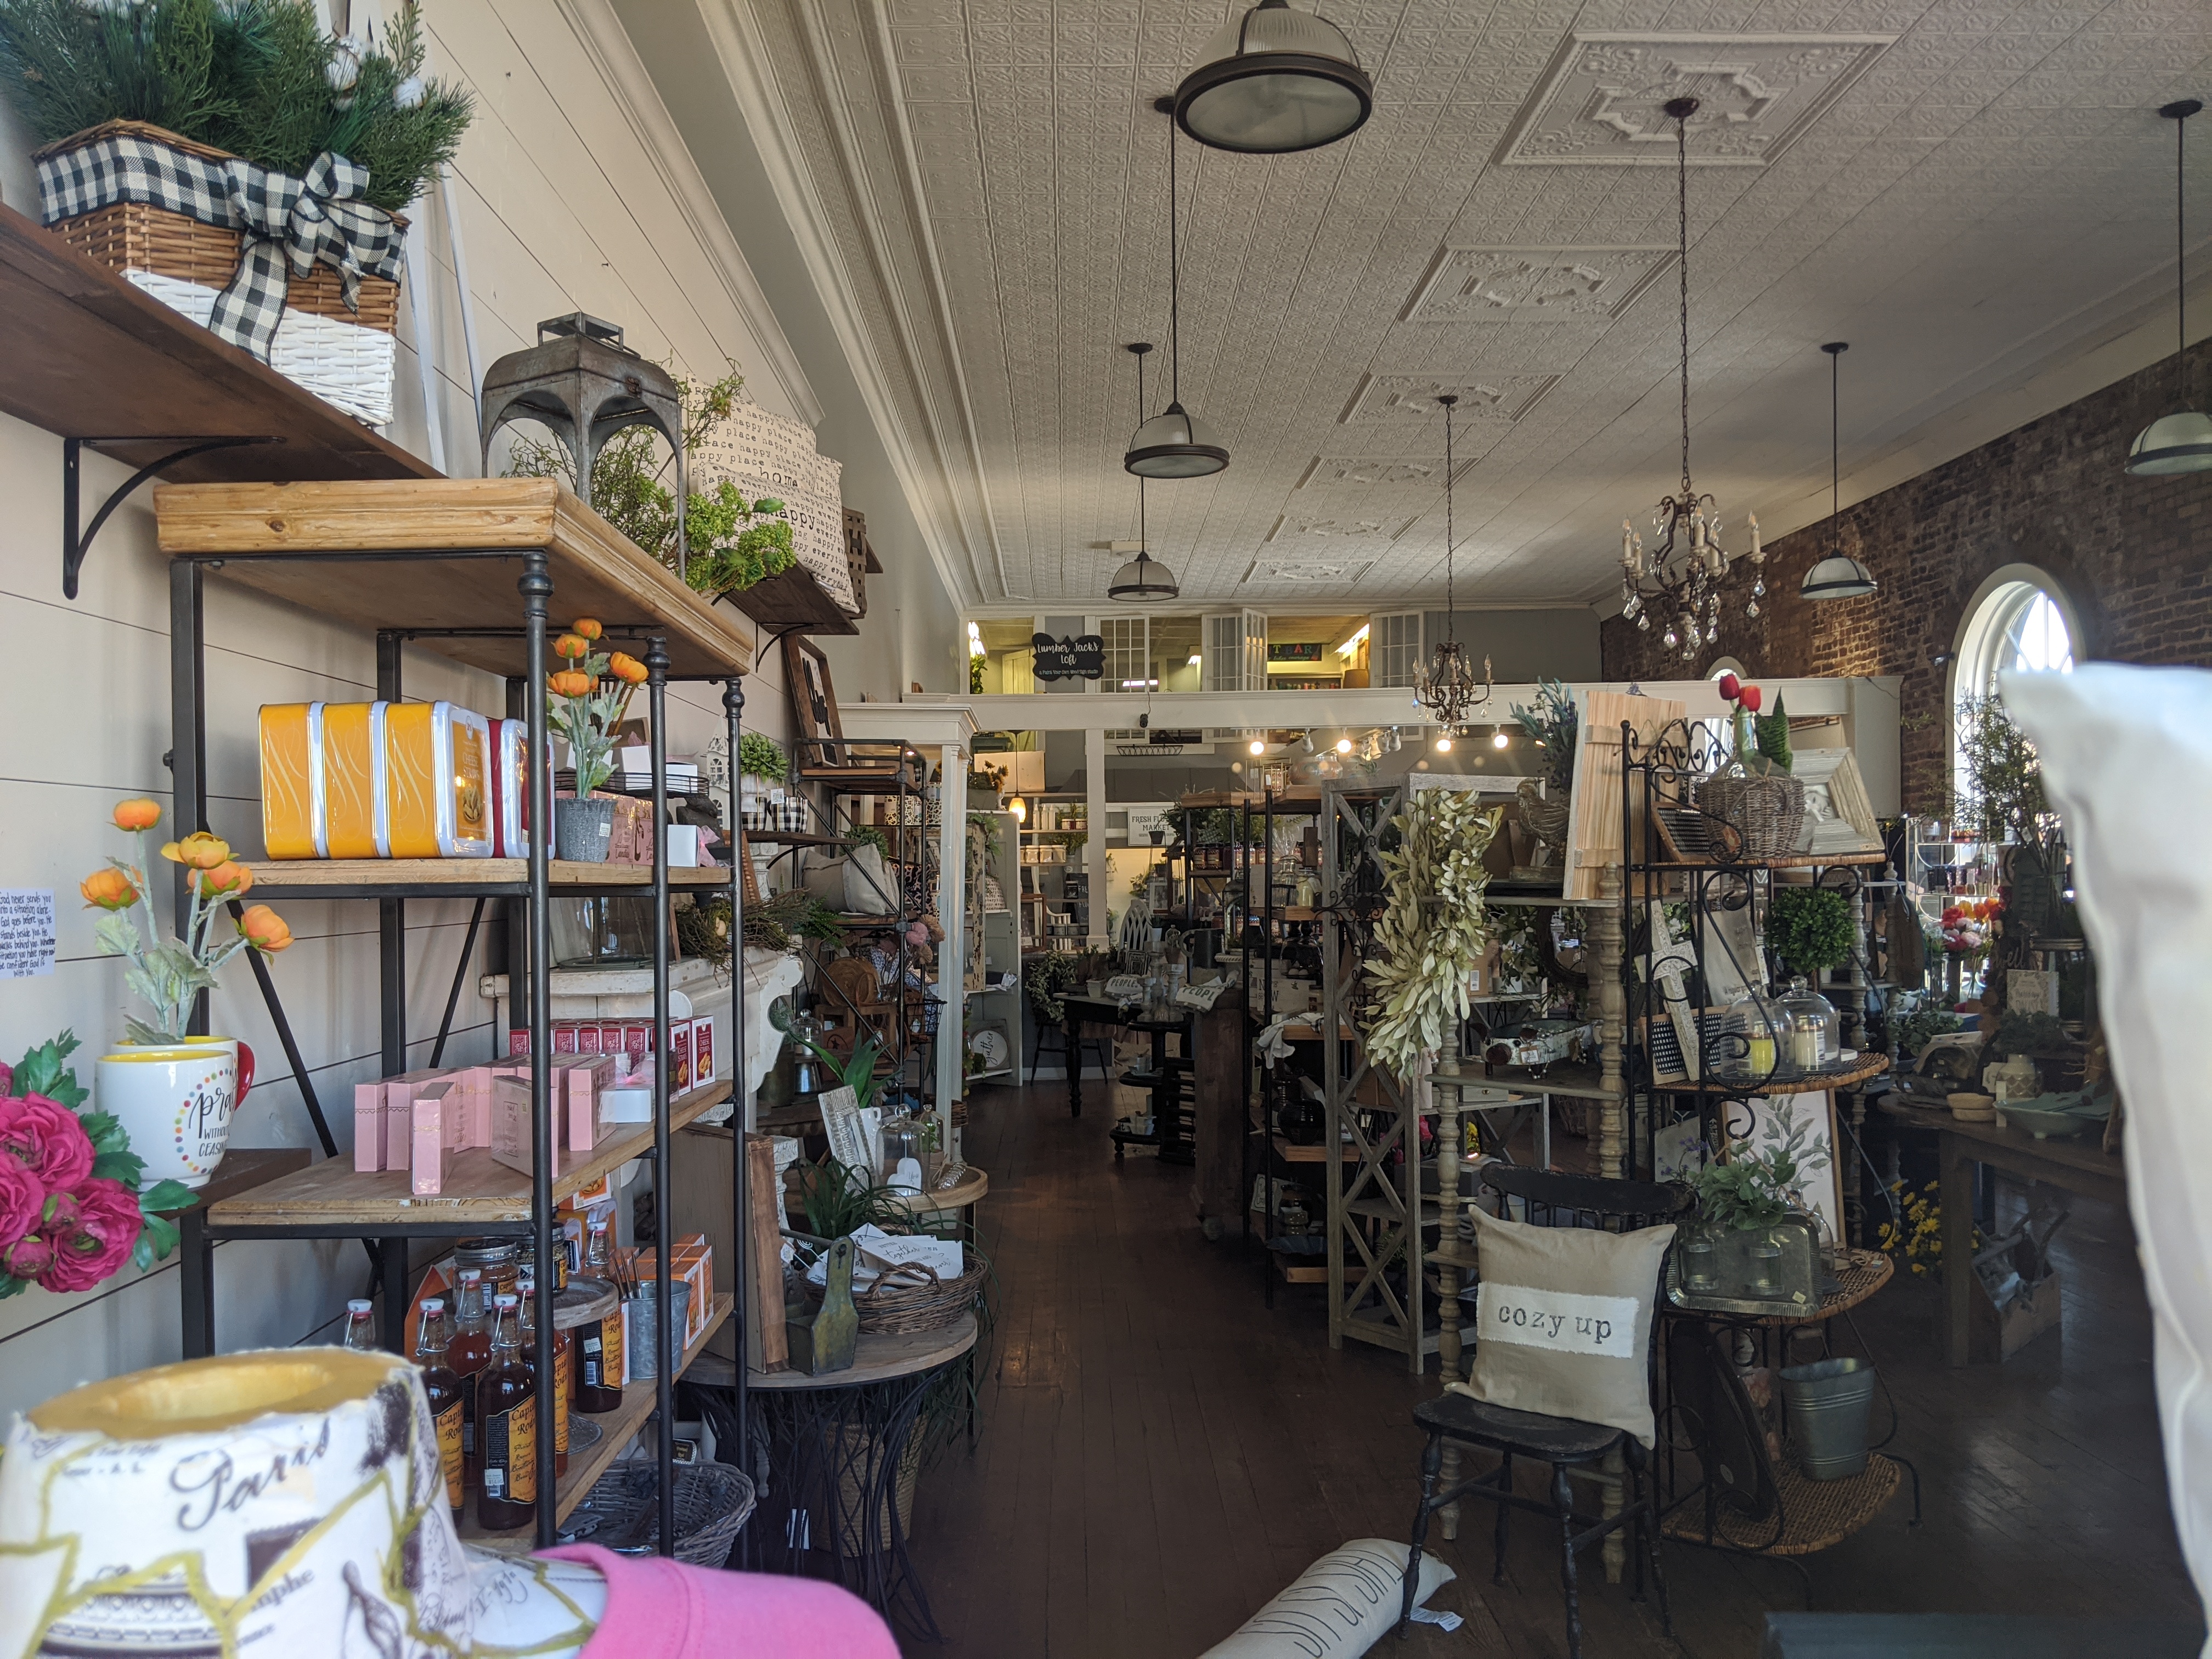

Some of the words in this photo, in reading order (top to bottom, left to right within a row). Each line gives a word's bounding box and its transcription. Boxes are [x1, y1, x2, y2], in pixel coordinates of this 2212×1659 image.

[733, 415, 761, 433] happy
[768, 428, 792, 444] place
[747, 409, 775, 425] happy
[778, 424, 802, 438] place
[726, 428, 757, 441] place
[761, 436, 788, 454] happy
[739, 443, 770, 458] happy
[776, 455, 802, 469] place
[691, 453, 723, 462] appy
[730, 455, 764, 466] place
[771, 460, 797, 476] happy
[759, 467, 798, 487] home
[789, 499, 814, 514] happy
[801, 495, 823, 509] happy
[816, 518, 837, 533] happy
[788, 540, 809, 552] appy
[813, 534, 834, 551] happy
[803, 555, 828, 570] happy
[1037, 643, 1070, 653] Lumber
[1060, 653, 1077, 665] Loft
[12, 895, 25, 904] never
[27, 891, 41, 904] sends
[42, 895, 51, 906] you
[1, 916, 10, 927] God
[12, 918, 21, 929] goes
[22, 915, 36, 924] before
[16, 928, 31, 938] beside
[30, 959, 39, 968] God
[980, 1031, 998, 1065] gather
[189, 1087, 232, 1139] pra
[883, 1244, 920, 1260] together
[1498, 1306, 1566, 1338] cozy
[1575, 1316, 1612, 1344] up
